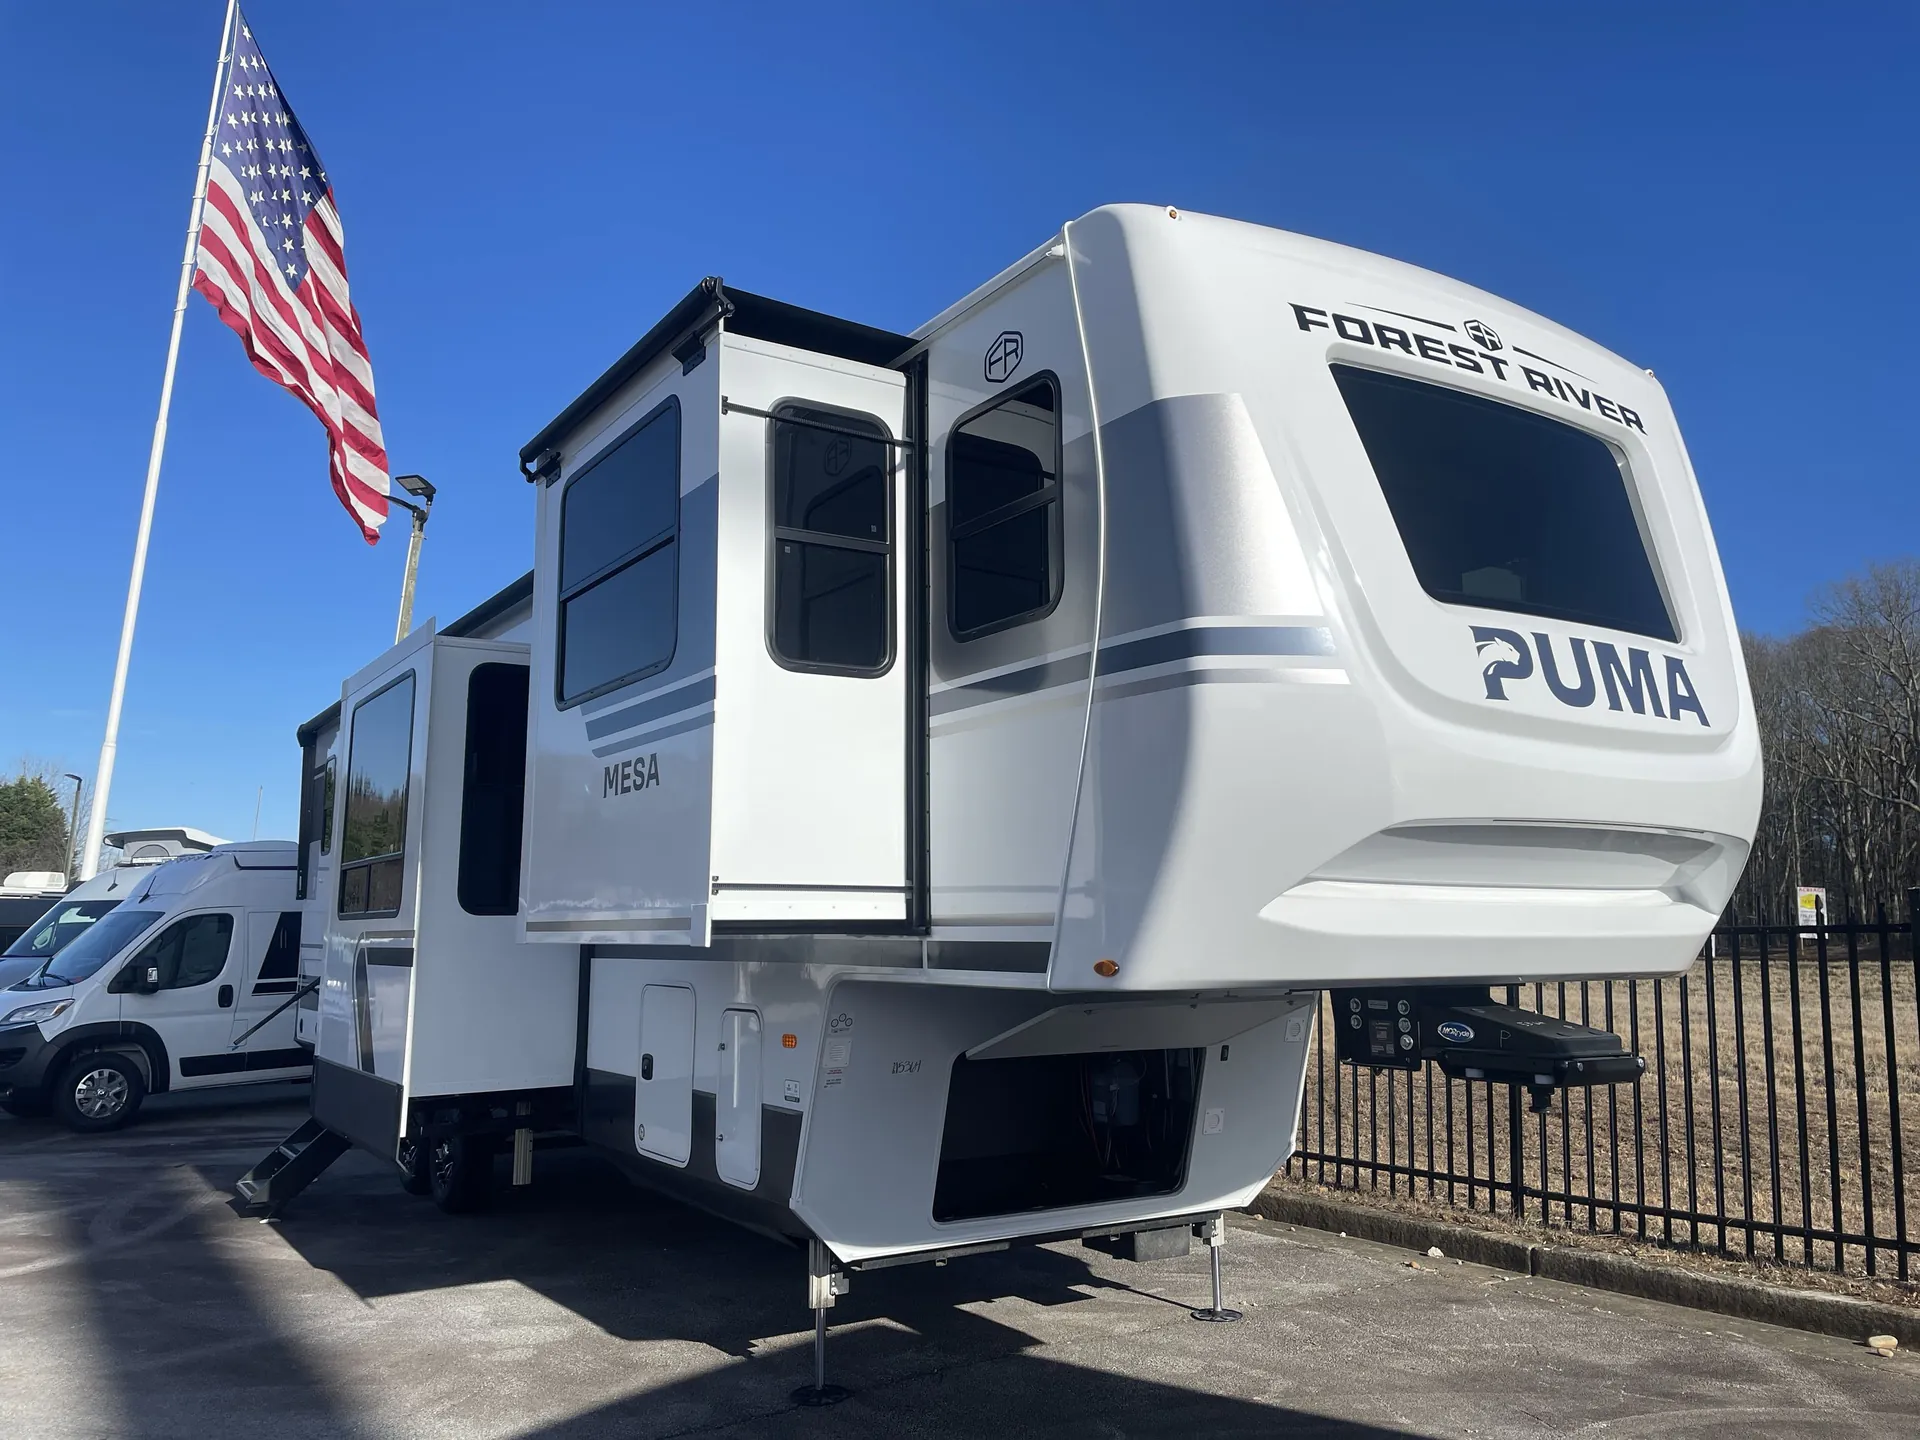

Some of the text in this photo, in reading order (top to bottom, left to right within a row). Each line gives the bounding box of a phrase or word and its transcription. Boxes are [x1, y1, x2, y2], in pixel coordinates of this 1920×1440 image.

[1287, 302, 1648, 435] FOREST RIVER
[1468, 625, 1711, 728] PUMA
[603, 753, 660, 798] MESA
